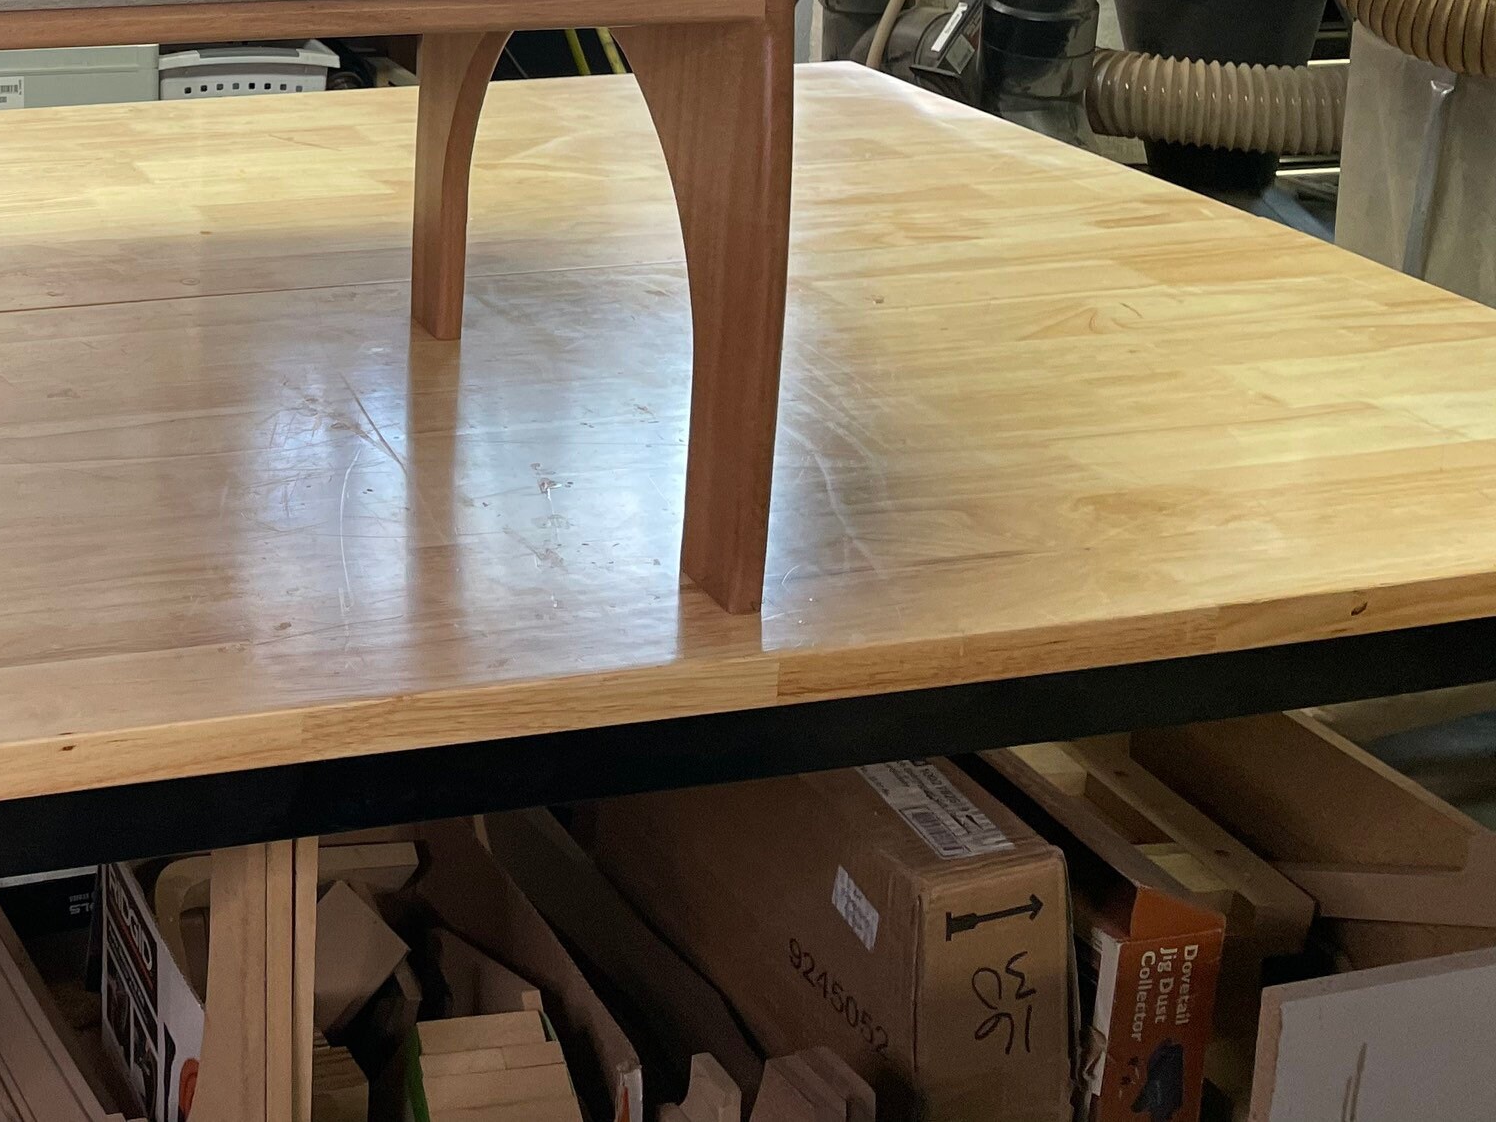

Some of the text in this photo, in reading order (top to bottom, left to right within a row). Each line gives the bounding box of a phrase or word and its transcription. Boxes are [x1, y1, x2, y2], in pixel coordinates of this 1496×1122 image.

[108, 863, 153, 971] RIDGID
[1131, 950, 1156, 1042] Collector
[1154, 947, 1178, 1024] Jig Dust
[1175, 944, 1199, 1025] Dovetail
